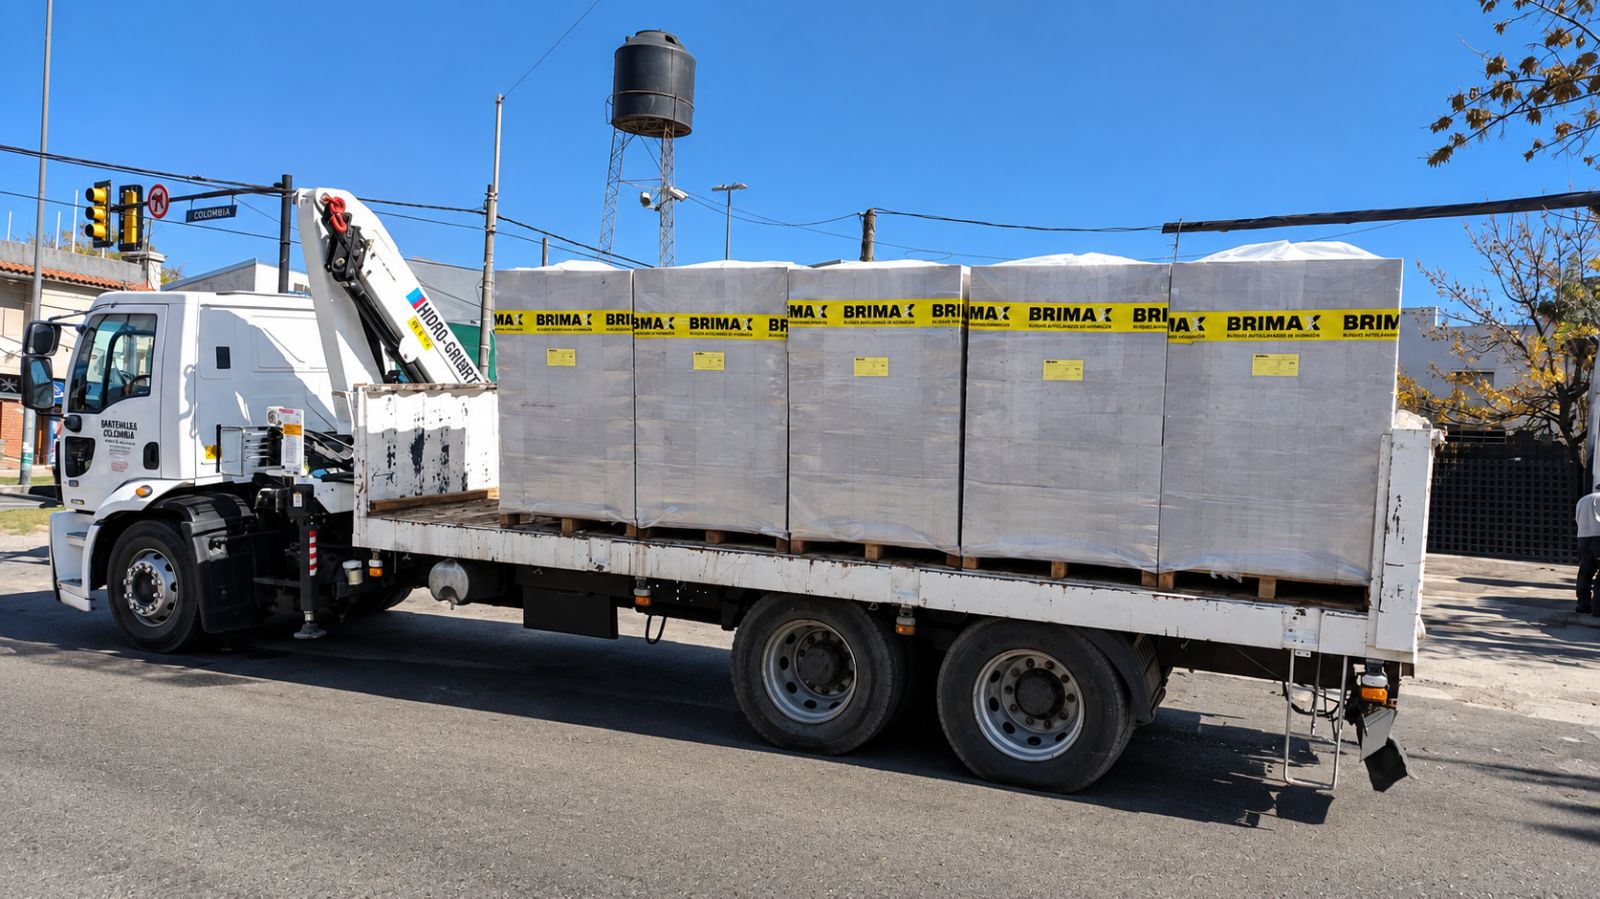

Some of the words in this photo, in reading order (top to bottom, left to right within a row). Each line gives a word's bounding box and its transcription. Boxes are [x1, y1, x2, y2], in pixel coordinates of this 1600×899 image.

[194, 208, 230, 219] COLOMBIA
[844, 303, 915, 318] BRIMAX
[1028, 307, 1113, 322] BRIMAX
[536, 313, 592, 326] BRIMAX
[689, 317, 753, 331] BRIMAX
[1226, 314, 1321, 331] BRIMAX
